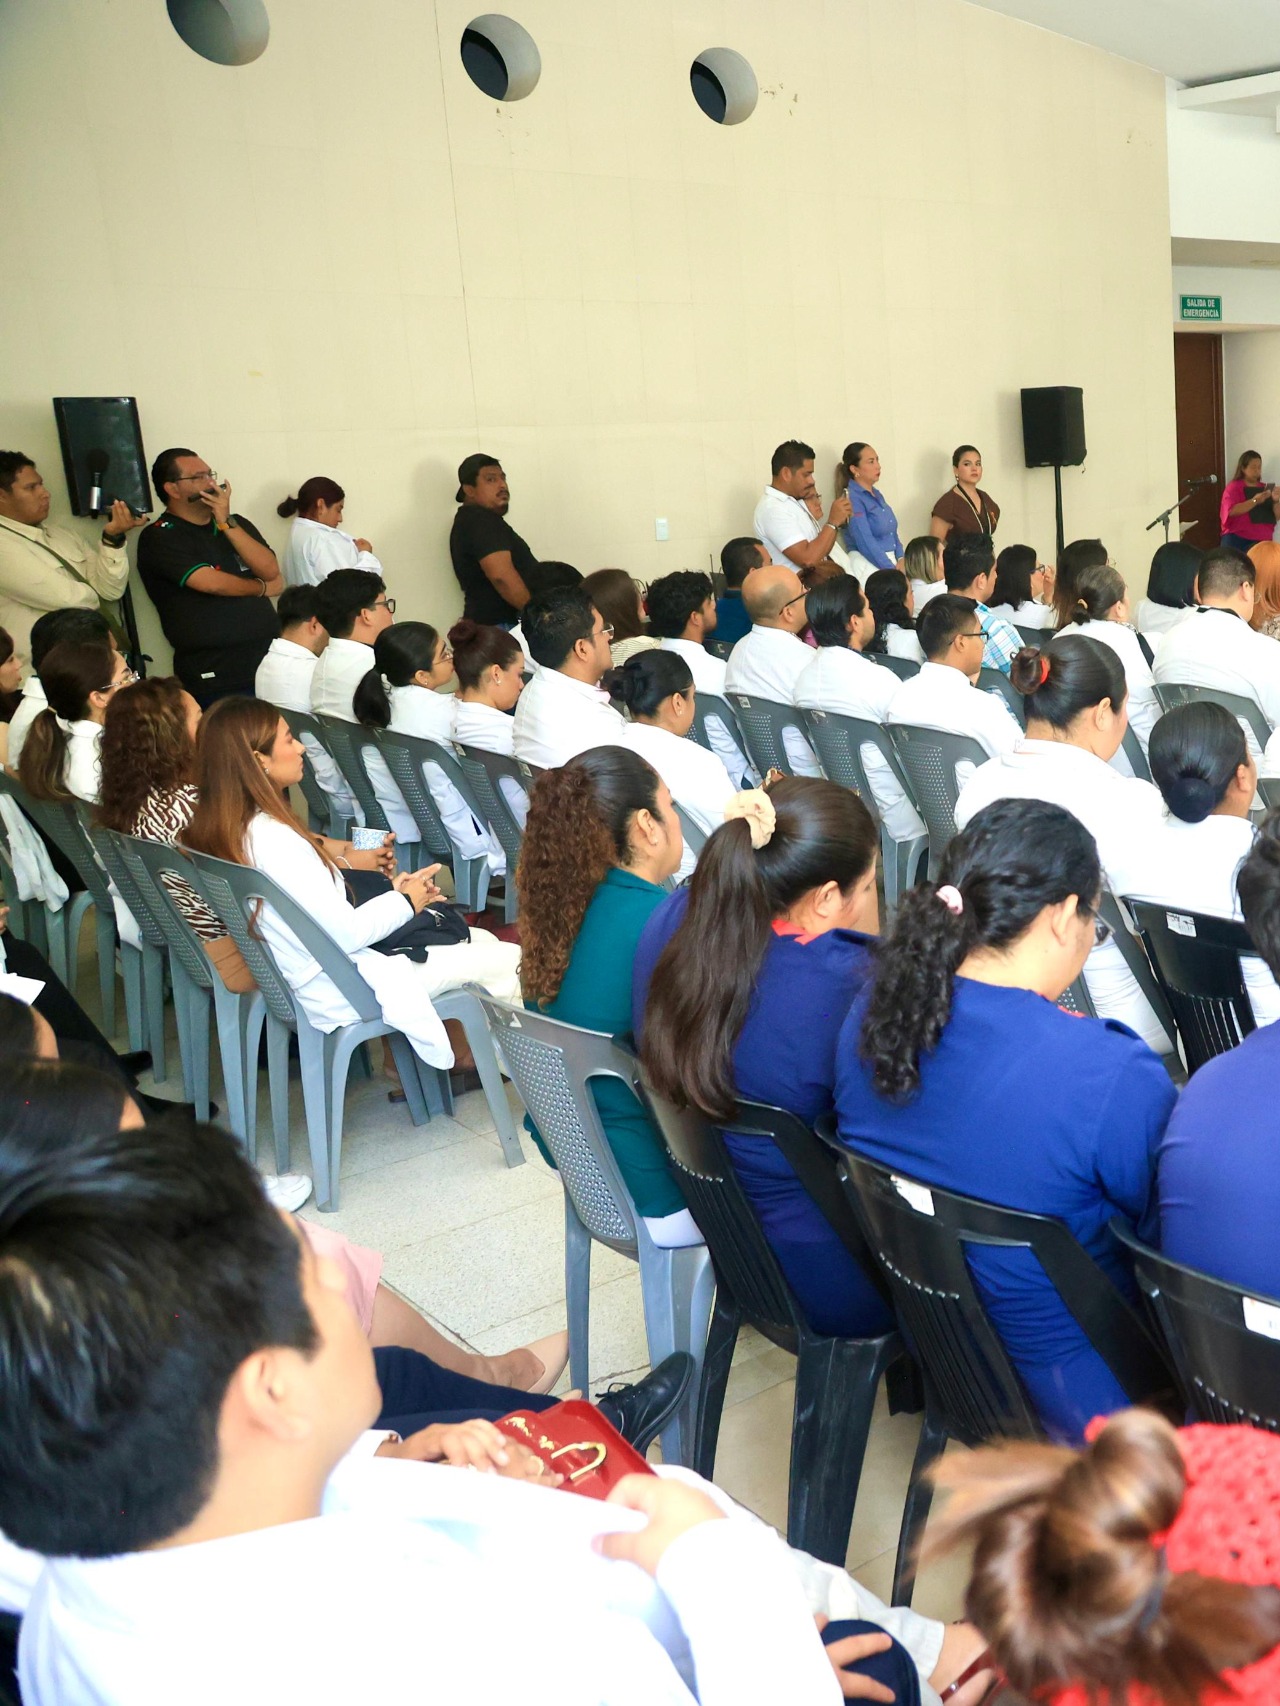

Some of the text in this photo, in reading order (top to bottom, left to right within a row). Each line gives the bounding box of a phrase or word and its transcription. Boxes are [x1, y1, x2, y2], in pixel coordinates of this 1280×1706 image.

[1186, 298, 1215, 308] SALIDA DE
[1183, 308, 1220, 318] EMERGENCIA
